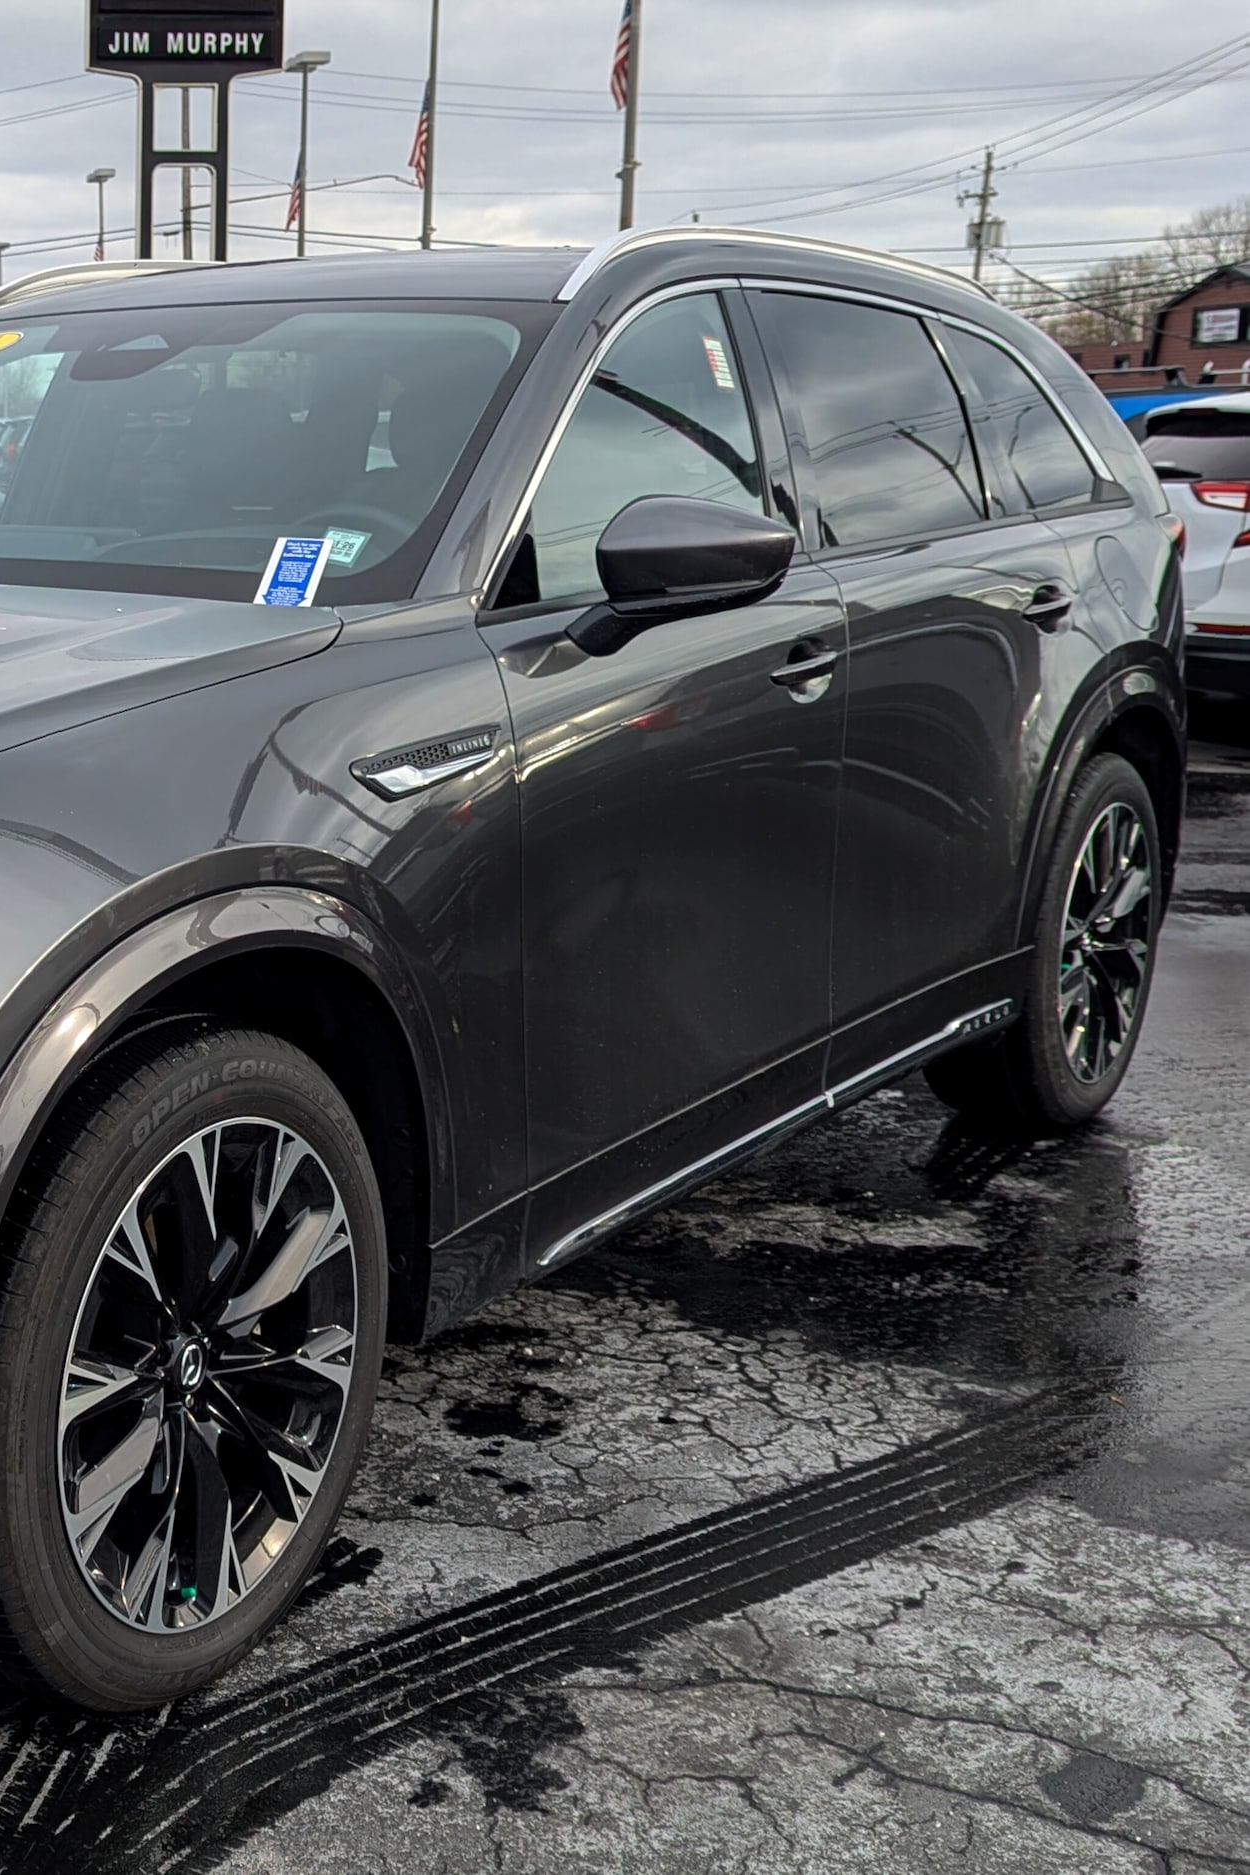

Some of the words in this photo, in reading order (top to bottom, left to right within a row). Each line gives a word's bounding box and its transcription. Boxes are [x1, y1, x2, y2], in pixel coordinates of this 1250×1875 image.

[108, 31, 150, 54] JIM
[167, 31, 264, 54] MURPHY
[131, 1070, 211, 1148] OPEN
